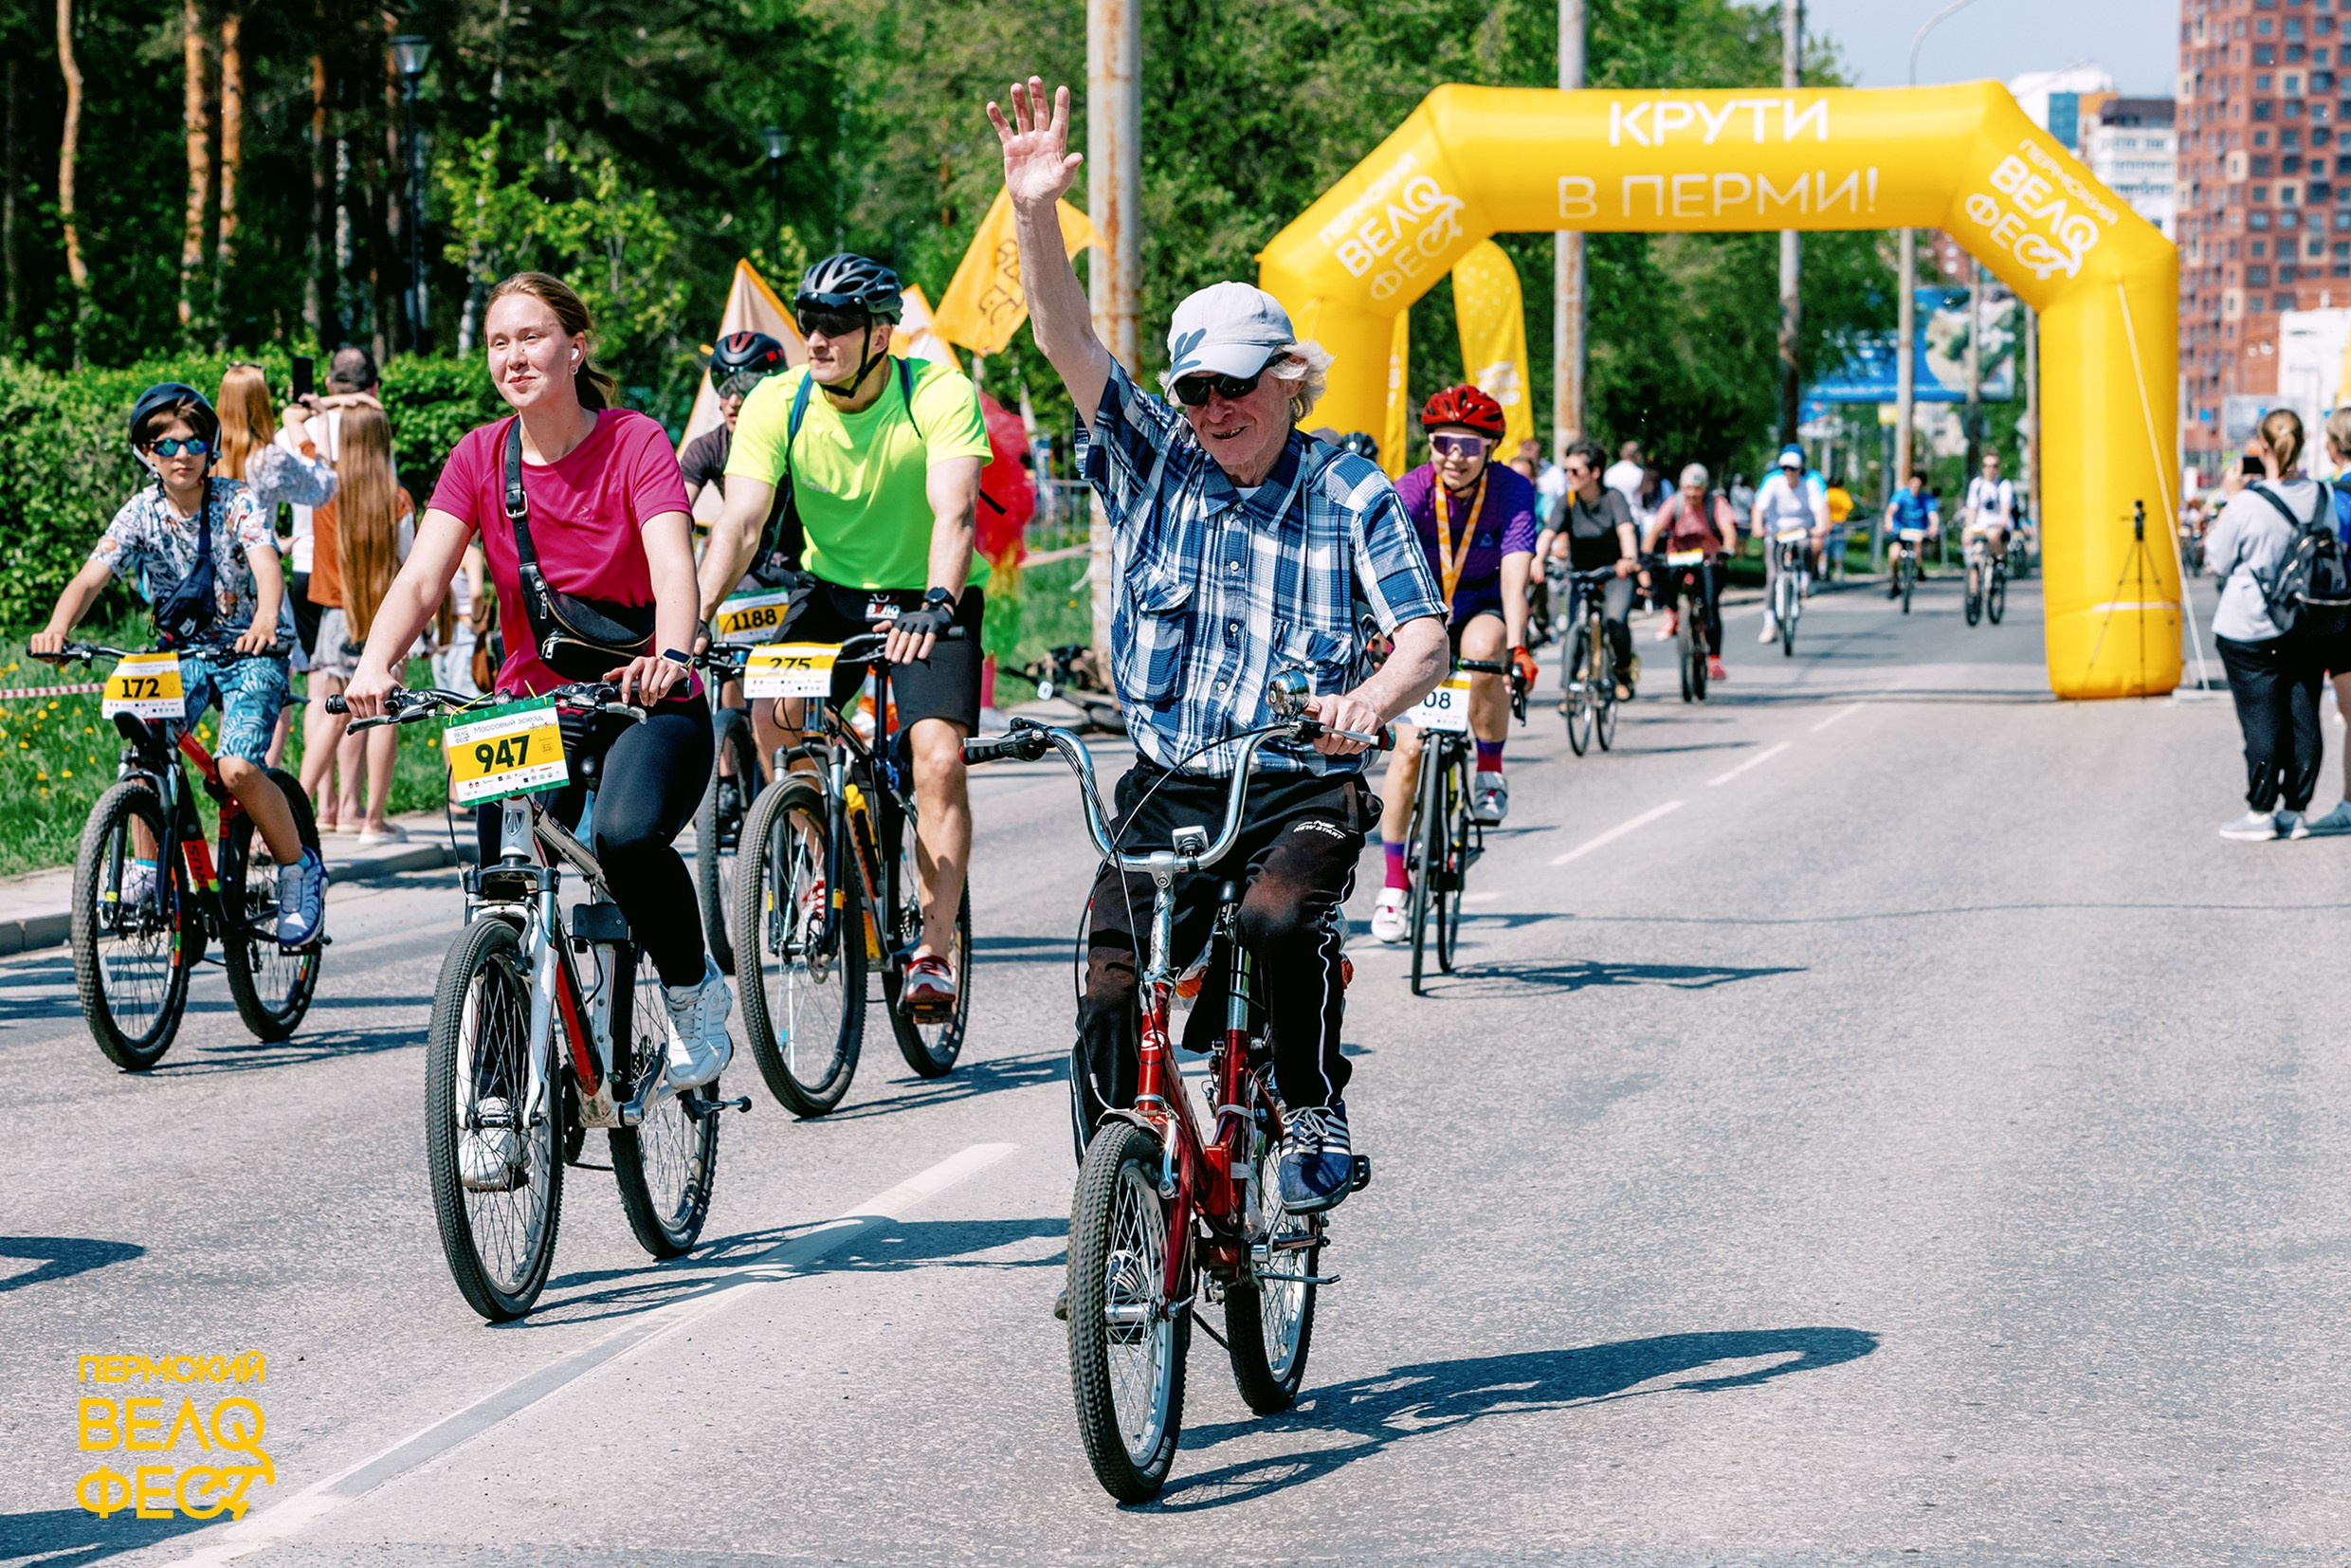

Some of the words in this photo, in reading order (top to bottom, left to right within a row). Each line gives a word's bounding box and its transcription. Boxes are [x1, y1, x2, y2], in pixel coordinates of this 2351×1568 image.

[1609, 98, 1829, 146] КРУТИ
[1558, 175, 1597, 218] В
[1622, 166, 1878, 217] ПЕРМИ!
[1988, 154, 2100, 258] ВЕЛО
[1335, 174, 1445, 278] ВЕЛО
[731, 608, 777, 631] 1188
[767, 657, 812, 675] 275
[122, 678, 160, 698] 172
[1416, 691, 1451, 709] 08
[474, 735, 531, 774] 947
[1316, 826, 1344, 840] START
